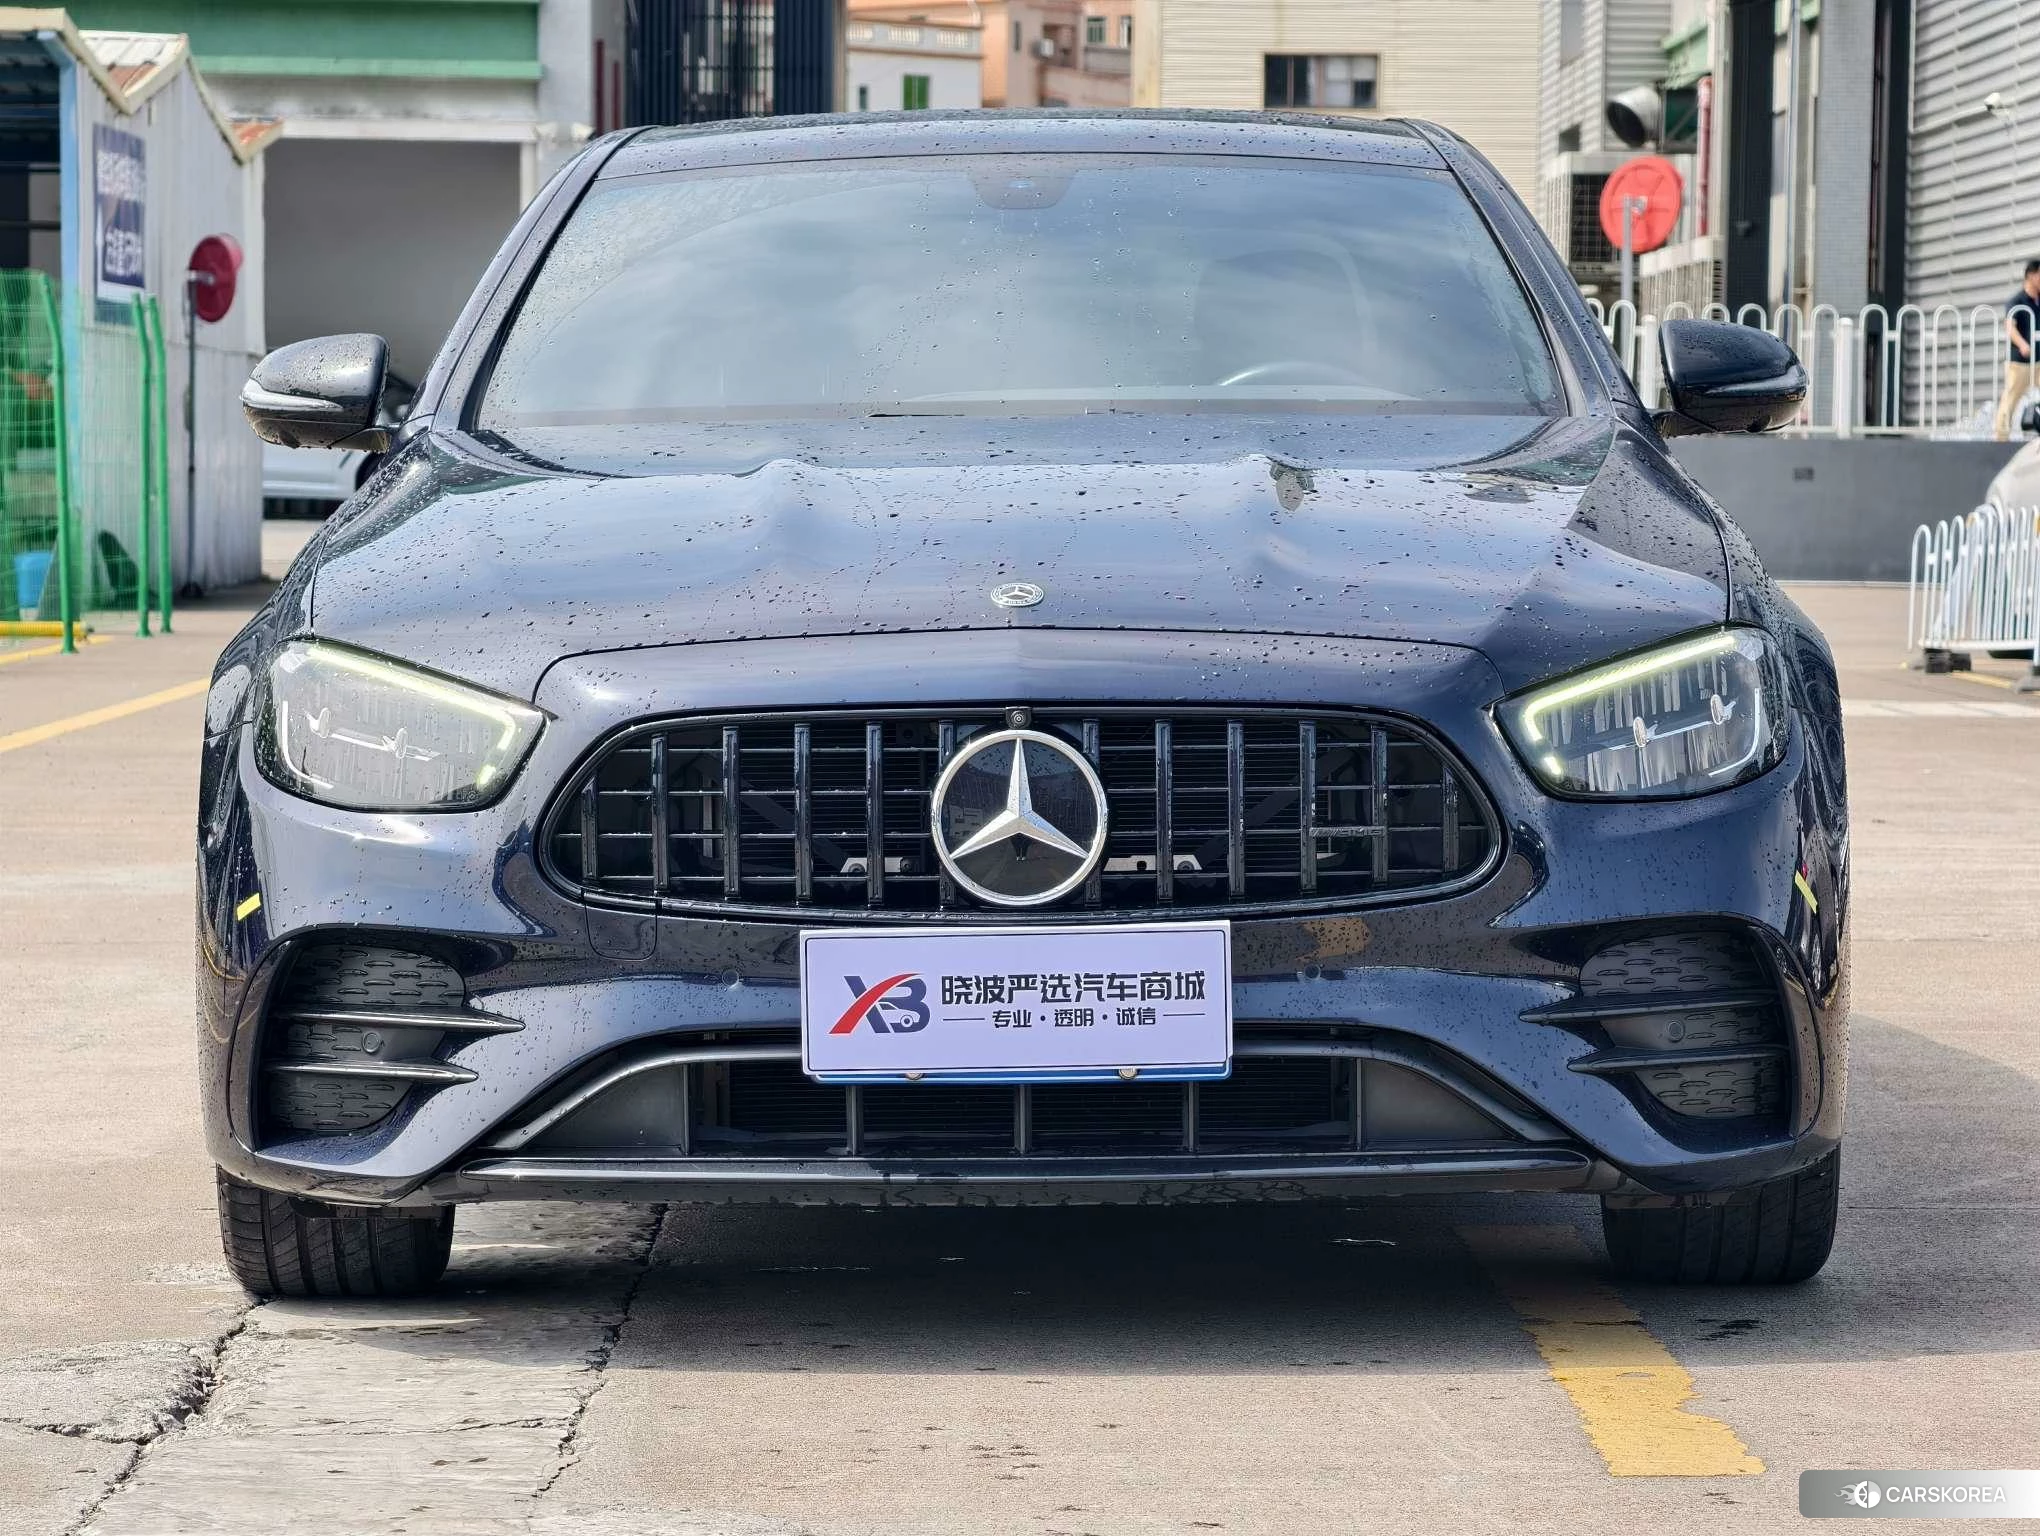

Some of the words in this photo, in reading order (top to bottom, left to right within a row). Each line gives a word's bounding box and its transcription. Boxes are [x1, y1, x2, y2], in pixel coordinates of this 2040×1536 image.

[941, 971, 1206, 1004] 晓波严选汽车商城
